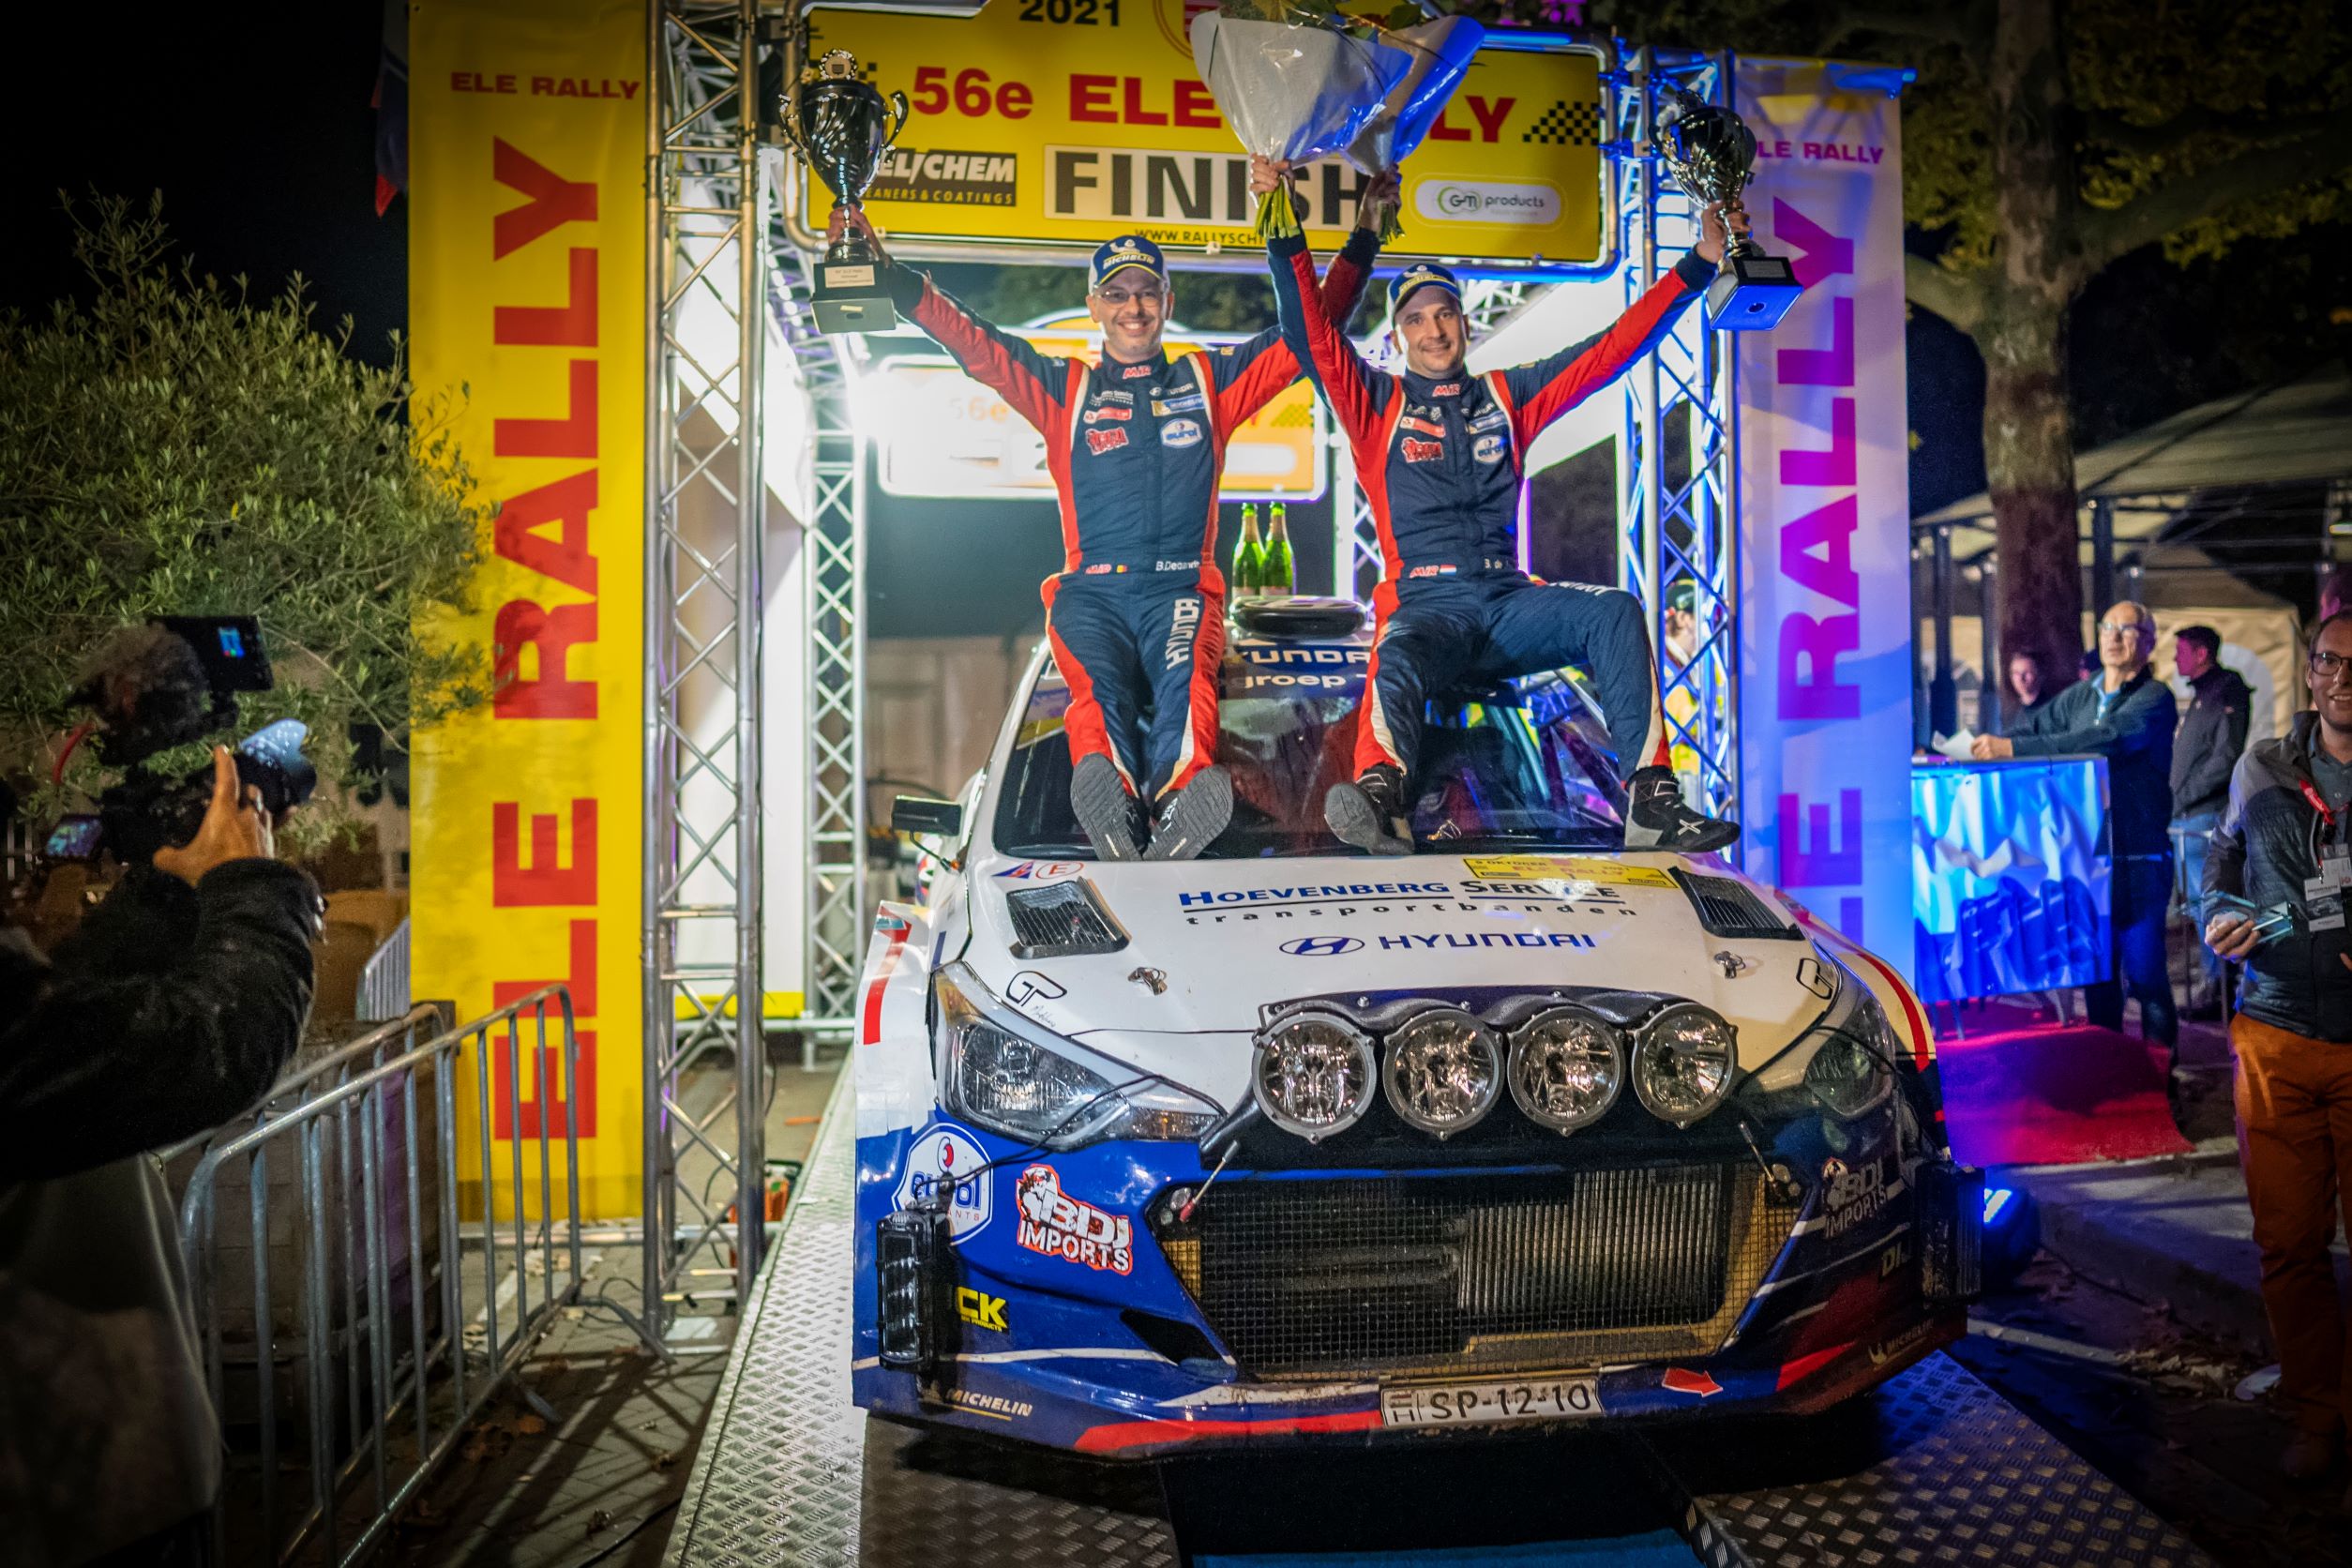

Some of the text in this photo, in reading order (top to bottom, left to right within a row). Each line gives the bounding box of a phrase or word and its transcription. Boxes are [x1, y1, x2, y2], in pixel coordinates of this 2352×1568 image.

[1019, 0, 1120, 26] 2021
[451, 72, 641, 99] ELE RALLY
[912, 67, 1222, 128] 56e ELE
[1756, 141, 1884, 165] LE RALLY
[878, 153, 1017, 185] EL/CHEM
[867, 187, 1013, 204] EANERS & COATINGS
[1485, 194, 1545, 208] products
[1135, 229, 1265, 245] WWW.RALLYSCHI
[1772, 196, 1861, 721] RALLY
[493, 136, 598, 1139] ELE RALLY
[1165, 597, 1200, 671] HYUNDA
[1178, 882, 1451, 907] HOEVENBERG
[1379, 932, 1597, 950] HYUNDAI
[1825, 1183, 1887, 1239] IMPORTS
[1018, 1220, 1129, 1272] IMPORTS
[957, 1286, 1008, 1328] CK
[945, 1388, 1033, 1418] MICHELIN
[1428, 1383, 1592, 1420] SP-12-10
